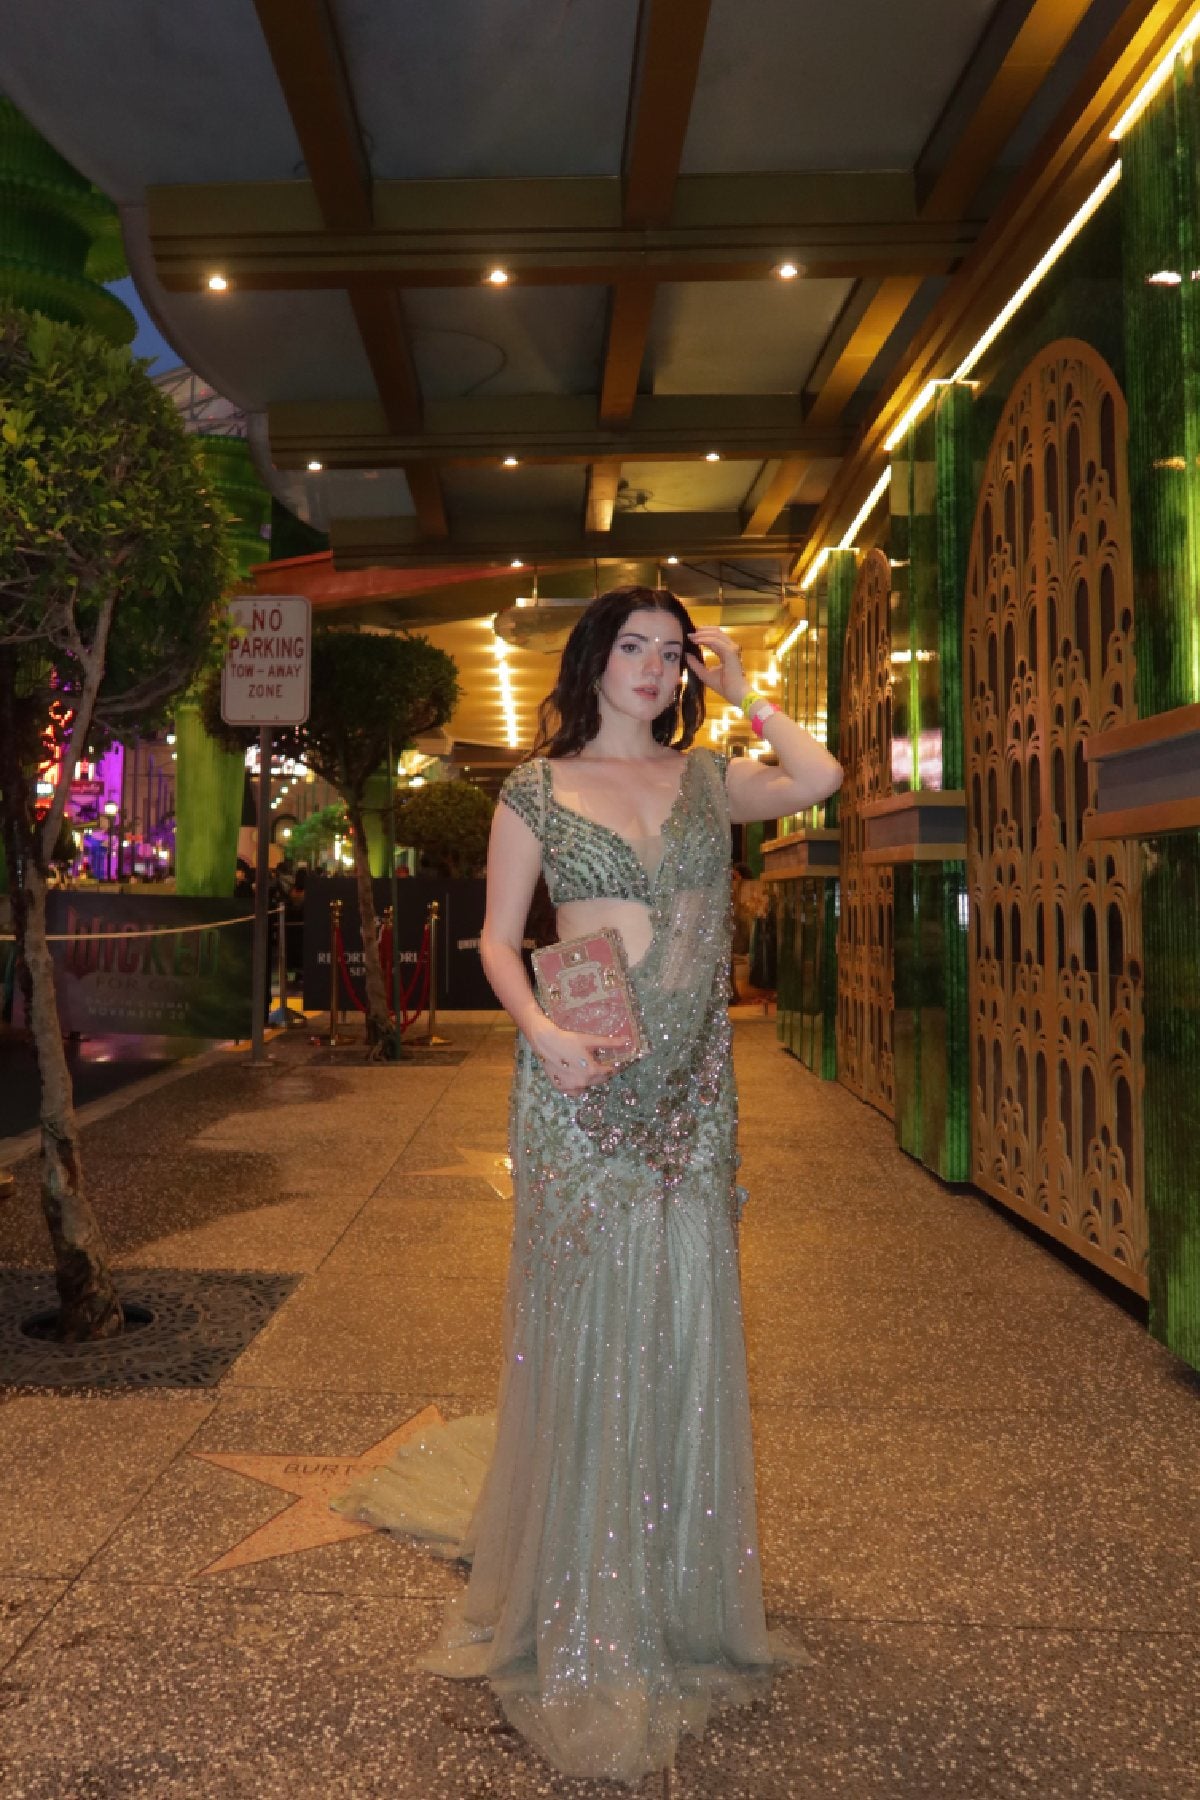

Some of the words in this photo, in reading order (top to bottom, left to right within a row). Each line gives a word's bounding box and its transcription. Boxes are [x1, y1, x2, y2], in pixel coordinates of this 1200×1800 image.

[252, 608, 283, 632] NO
[229, 636, 304, 659] PARKING
[248, 684, 283, 699] ZONE
[65, 905, 220, 979] WICKED
[283, 1463, 353, 1476] BURT
